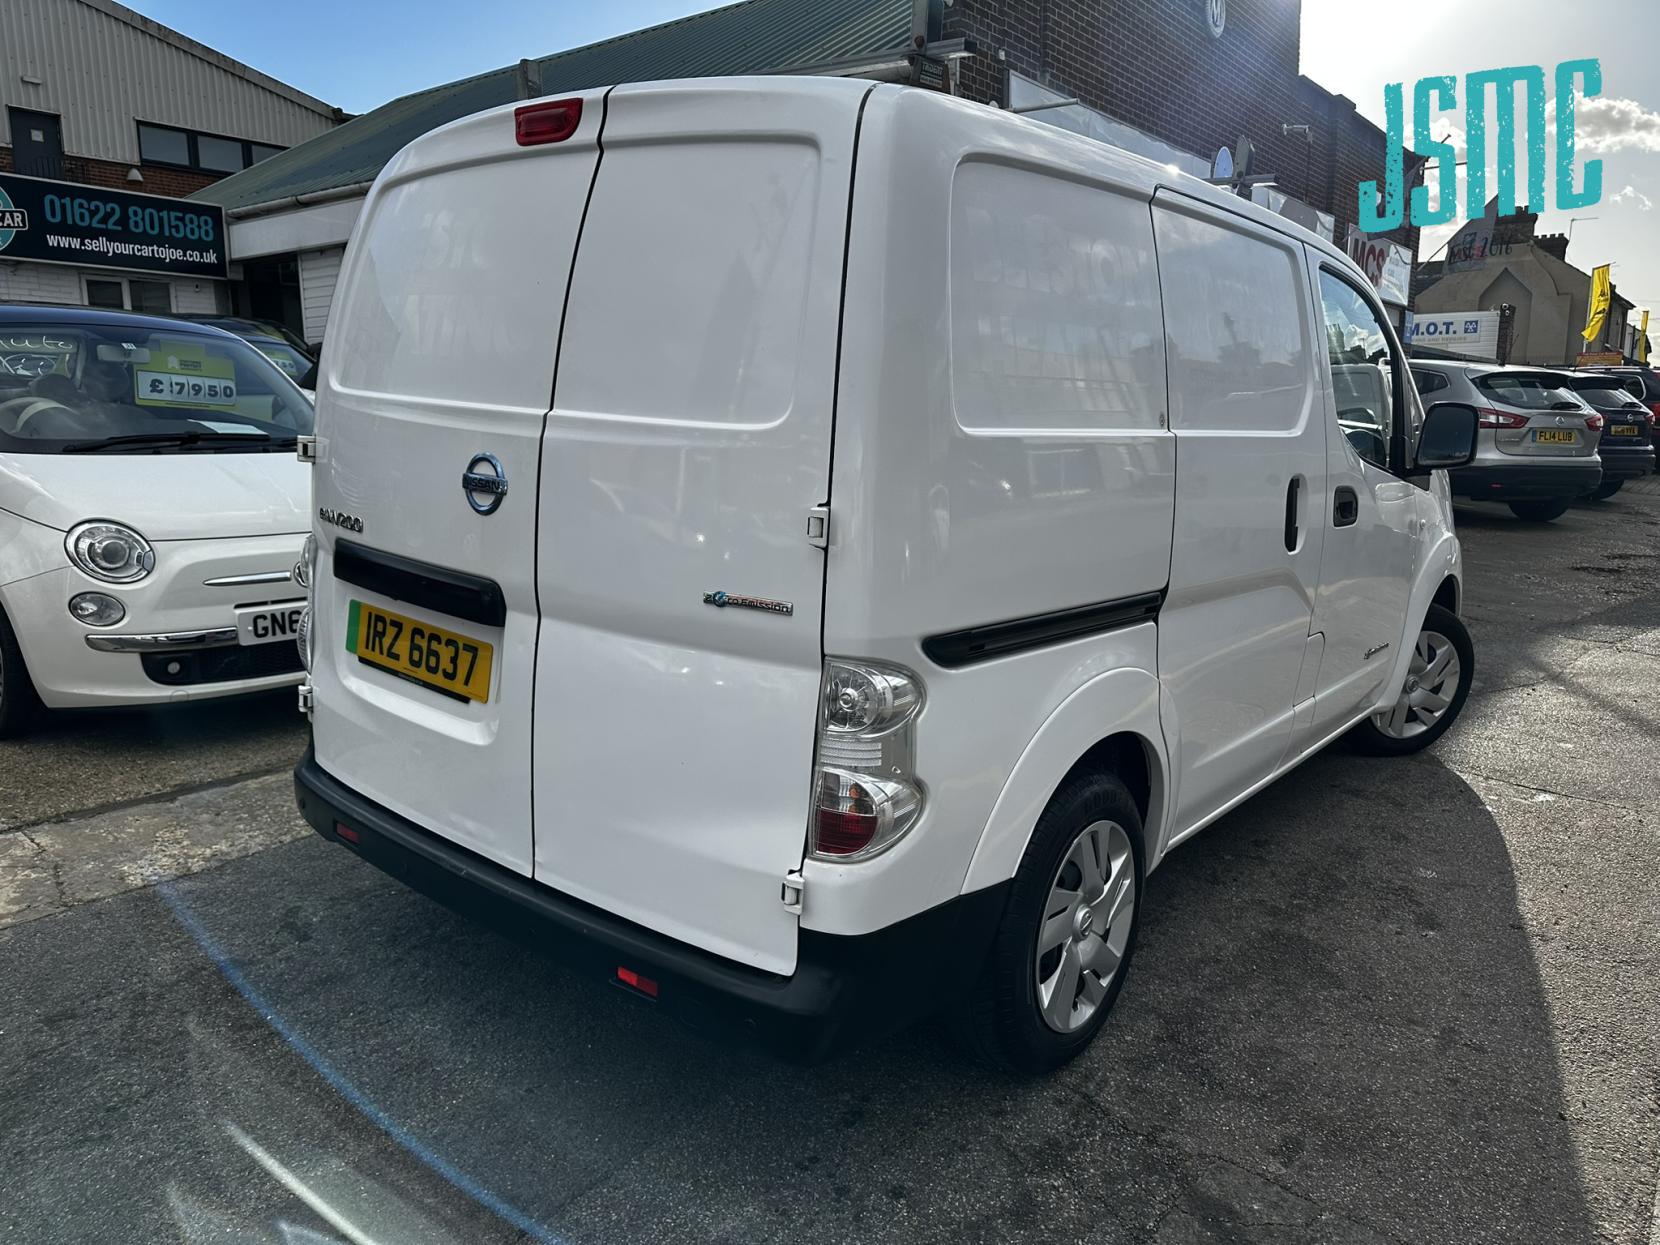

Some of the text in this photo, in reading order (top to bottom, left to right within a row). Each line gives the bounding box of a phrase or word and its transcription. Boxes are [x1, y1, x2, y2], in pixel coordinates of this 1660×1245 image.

[0, 213, 23, 227] AR
[43, 194, 214, 241] 01622 801588
[46, 234, 217, 264] www.sellyourcartojoe.co.uk
[1412, 321, 1457, 336] M.O.T.
[1538, 431, 1573, 442] FL14 LUB
[365, 611, 403, 661] IRZ
[408, 627, 478, 687] 6637
